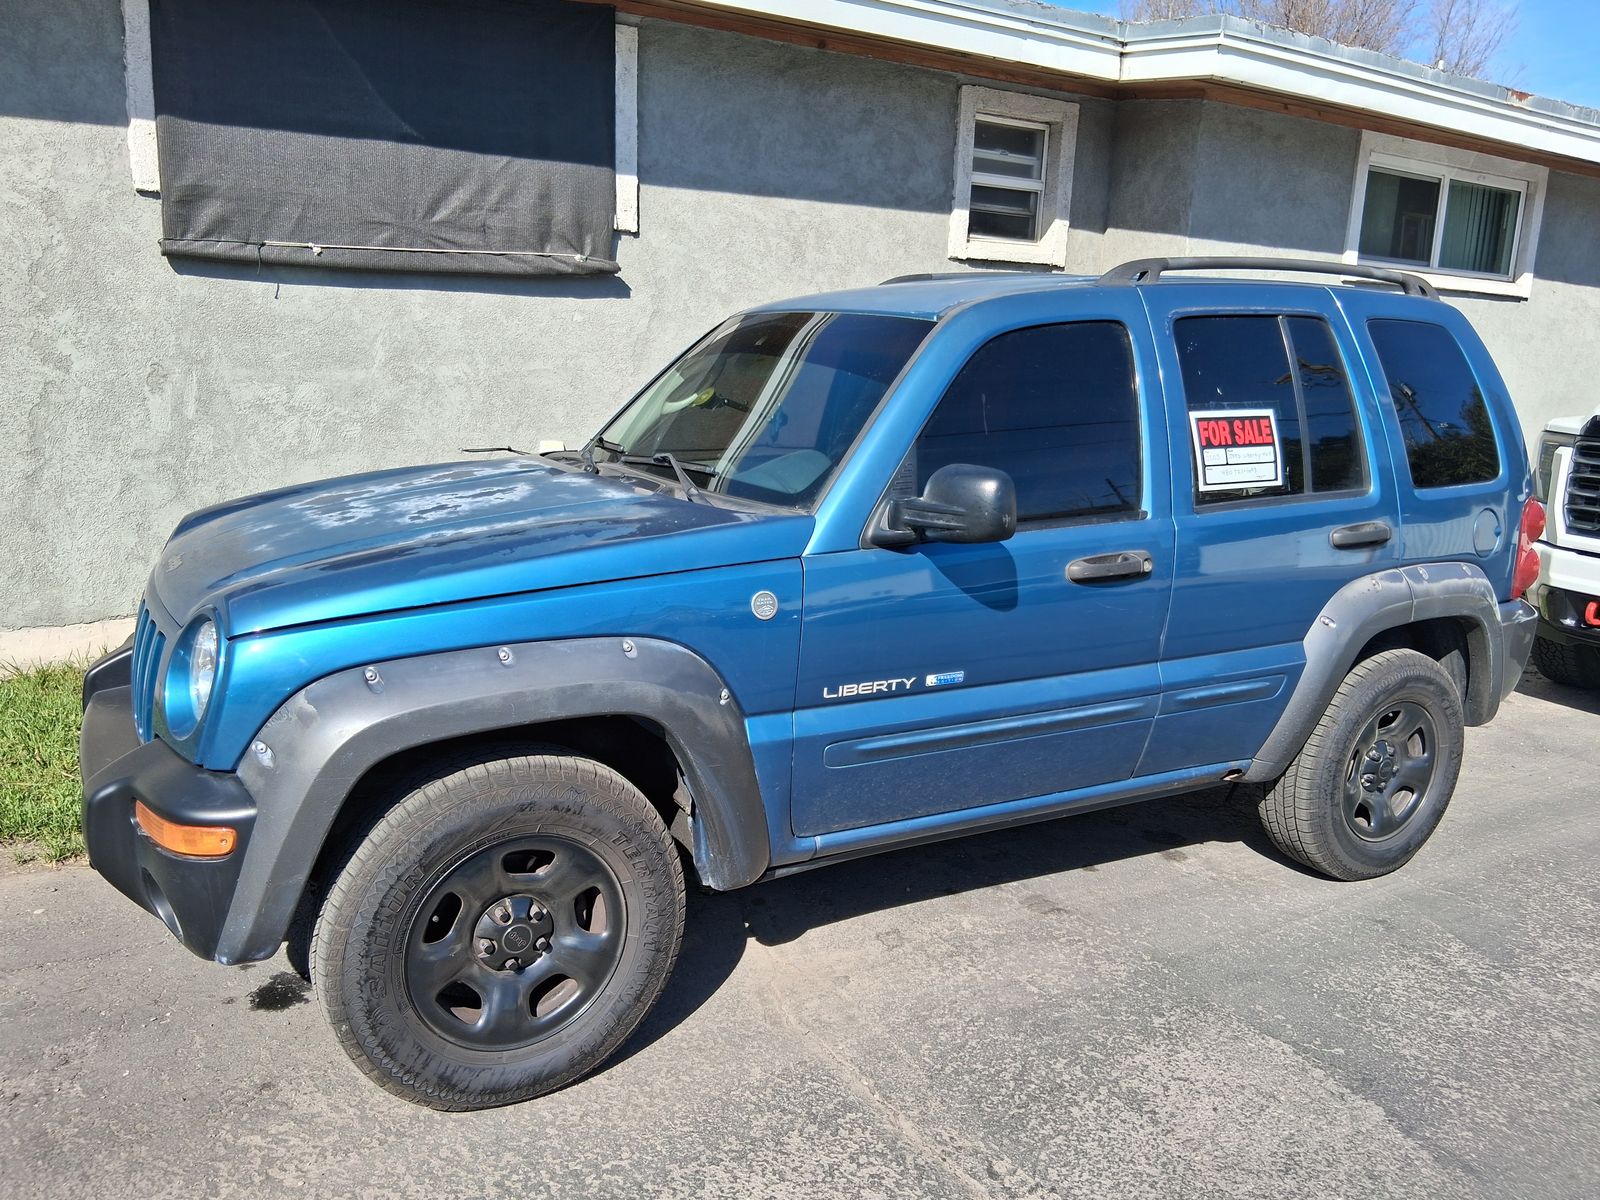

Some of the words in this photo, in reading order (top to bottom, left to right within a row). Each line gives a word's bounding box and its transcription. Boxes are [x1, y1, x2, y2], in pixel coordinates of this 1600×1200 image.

[1198, 420, 1233, 447] FOR
[1233, 418, 1273, 445] SALE
[823, 677, 917, 699] LIBERTY
[368, 862, 426, 1001] SAILUN
